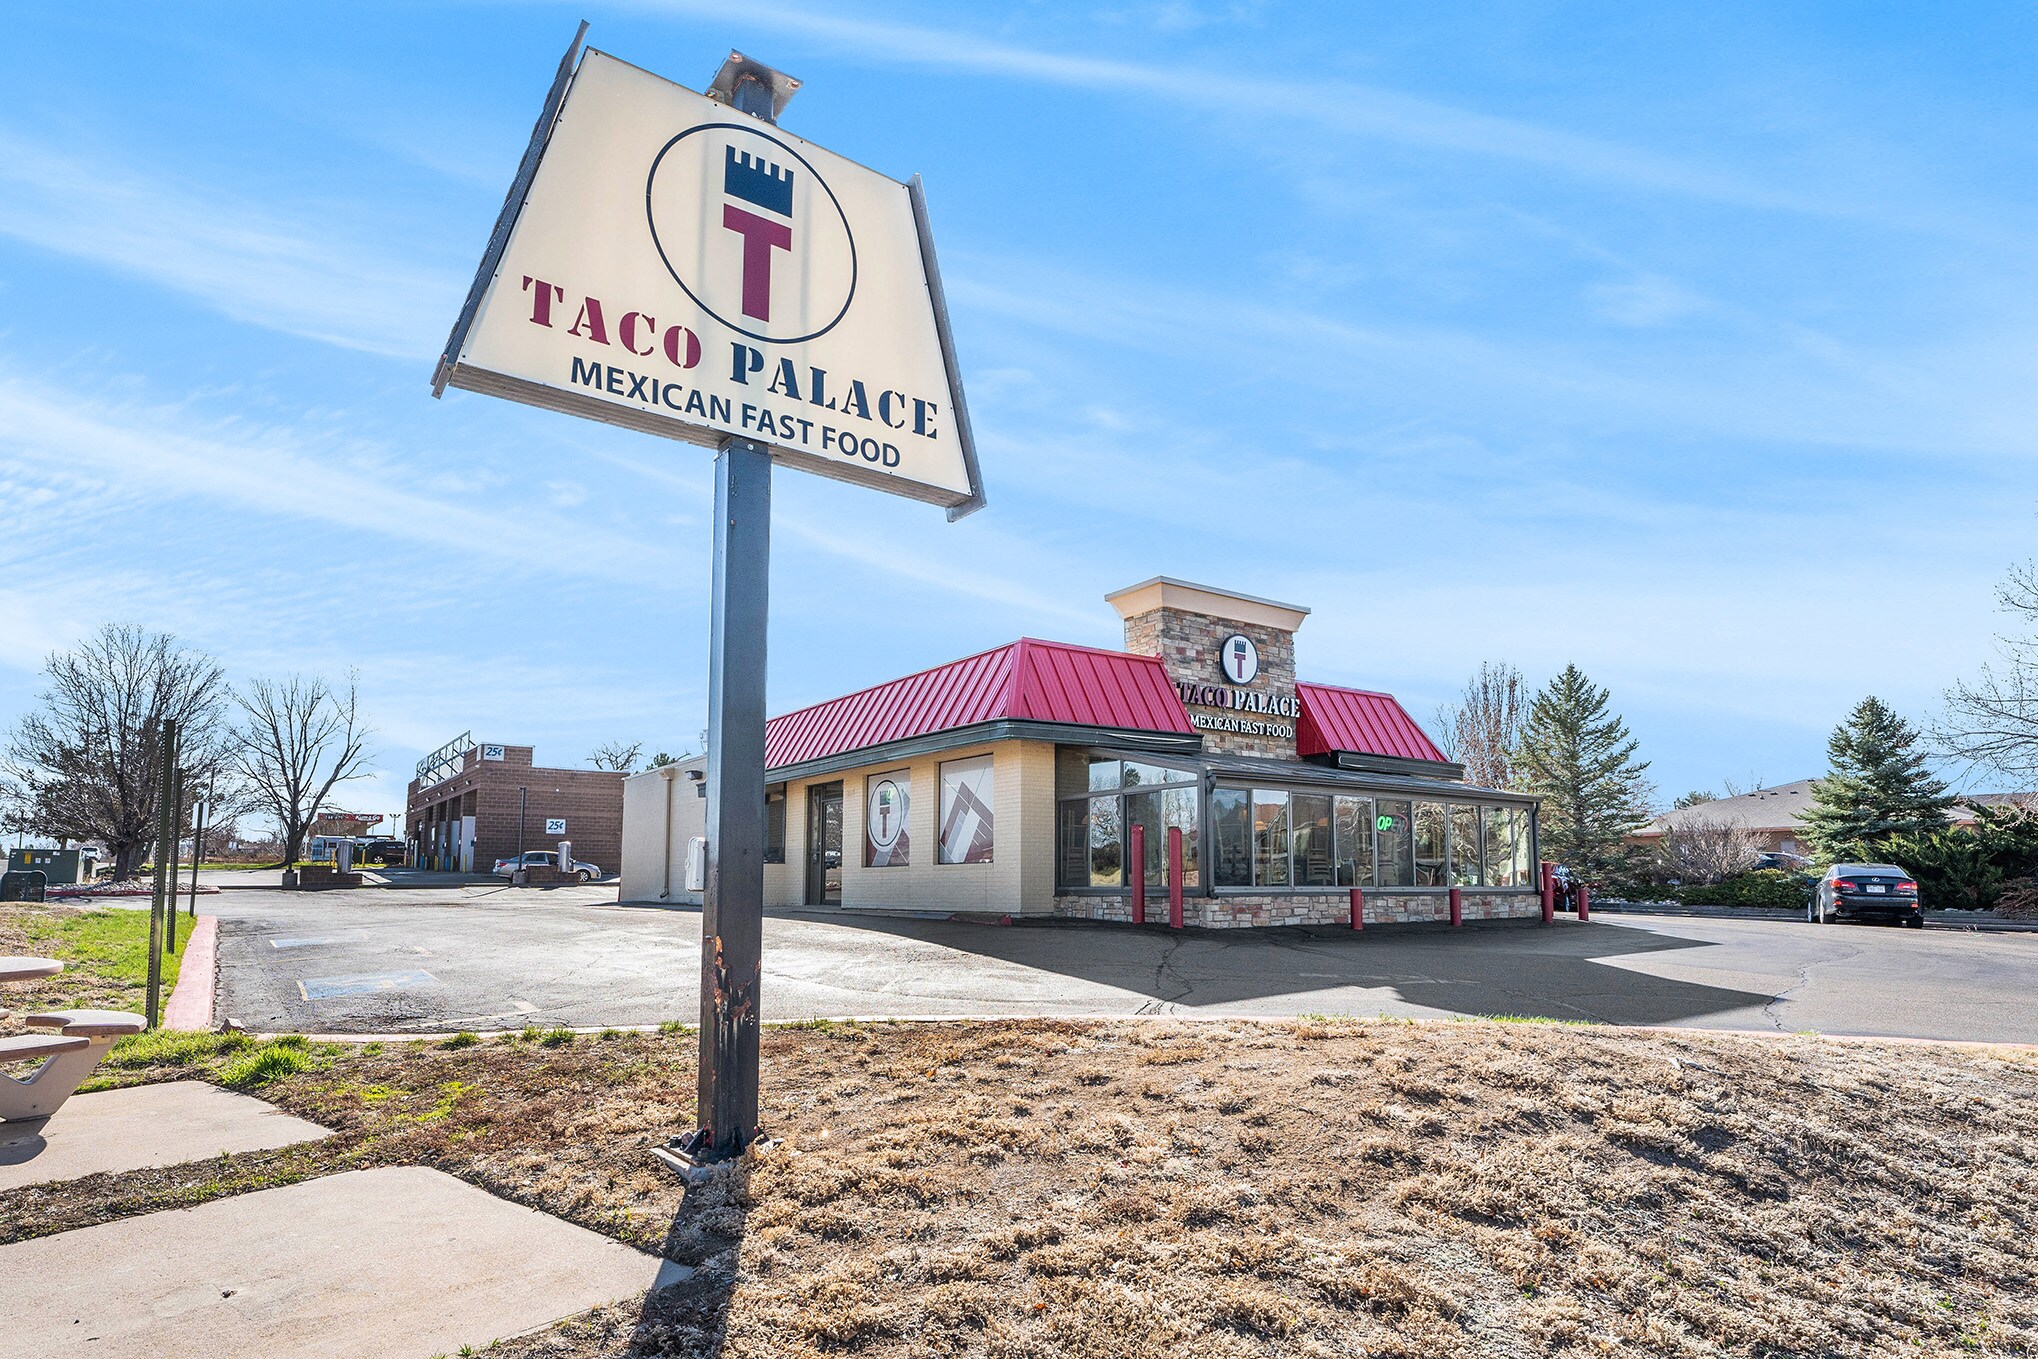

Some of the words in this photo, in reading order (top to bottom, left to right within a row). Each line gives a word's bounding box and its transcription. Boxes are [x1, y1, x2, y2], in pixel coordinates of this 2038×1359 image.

[723, 203, 793, 323] T
[522, 275, 702, 369] TACO
[729, 341, 938, 440] PALACE
[570, 356, 732, 424] MEXICAN
[741, 403, 814, 445] FAST
[822, 425, 901, 468] FOOD
[1234, 652, 1247, 679] T
[1178, 682, 1229, 708] TACO
[1233, 689, 1301, 718] PALACE
[1190, 714, 1239, 732] MEXICAN
[1240, 720, 1265, 735] FAST
[1266, 723, 1293, 738] FOOD
[485, 746, 503, 757] 25¢
[547, 820, 564, 830] 25¢
[879, 806, 891, 839] T
